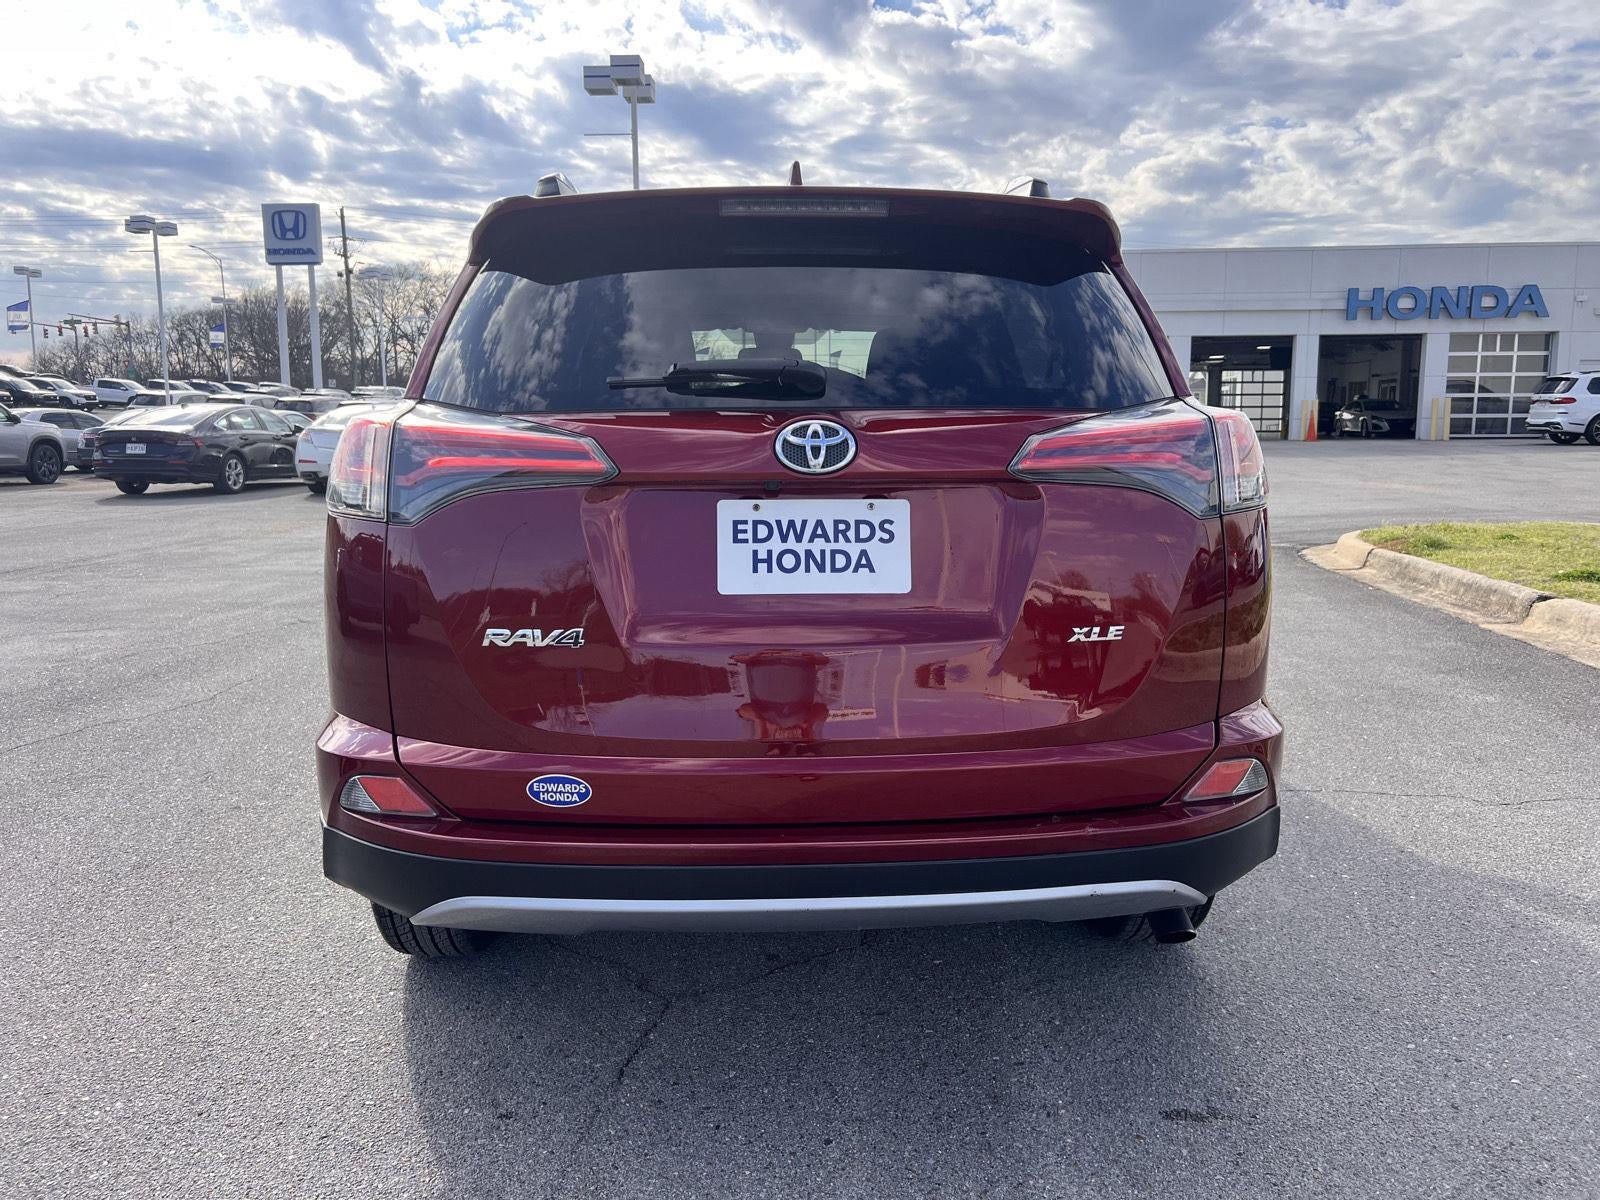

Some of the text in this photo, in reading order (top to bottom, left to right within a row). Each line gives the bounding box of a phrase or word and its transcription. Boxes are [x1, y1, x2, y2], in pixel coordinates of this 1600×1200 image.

[1346, 284, 1550, 320] HONDA
[732, 519, 895, 544] EDWARDS
[752, 548, 876, 574] HONDA
[482, 628, 585, 648] RAV4
[1067, 625, 1125, 642] XLE
[533, 783, 586, 793] EDWARDS
[540, 792, 580, 802] HONDA
